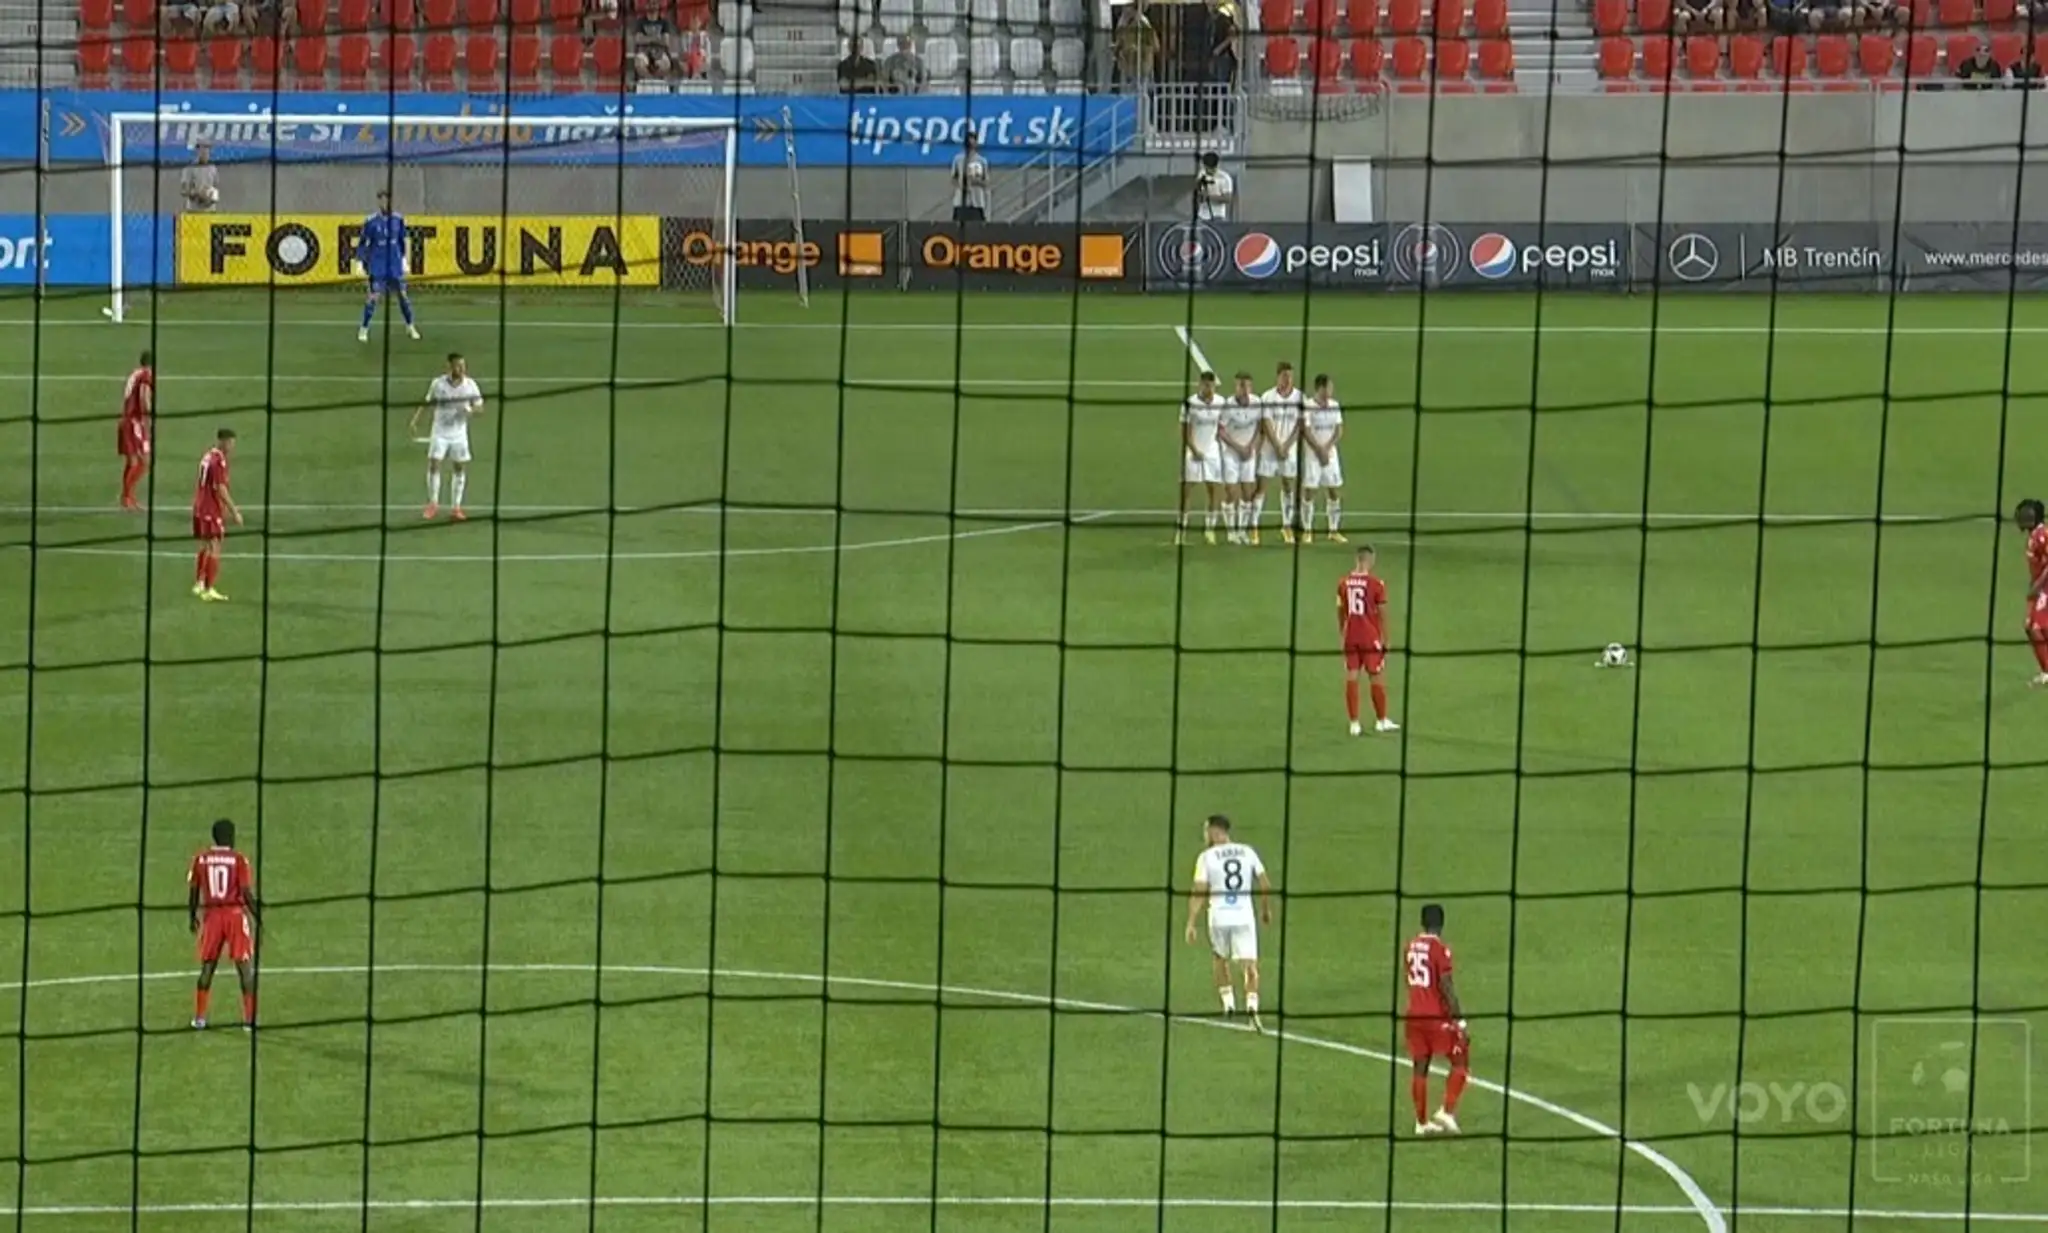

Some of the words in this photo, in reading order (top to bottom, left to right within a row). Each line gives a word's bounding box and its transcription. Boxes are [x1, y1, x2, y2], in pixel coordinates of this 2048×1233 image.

[309, 103, 347, 142] si
[851, 106, 1075, 155] tipsport.sk
[683, 231, 821, 274] Orange
[923, 235, 1063, 274] Orange
[1286, 239, 1380, 273] pepsi
[1523, 239, 1618, 273] pepsi
[1763, 247, 1798, 266] MB
[1804, 246, 1880, 267] Trenčín
[1354, 267, 1379, 277] max
[1591, 267, 1616, 277] max
[1347, 587, 1365, 615] 16
[208, 865, 229, 898] 10
[1223, 859, 1243, 890] 8
[1407, 952, 1430, 988] 35
